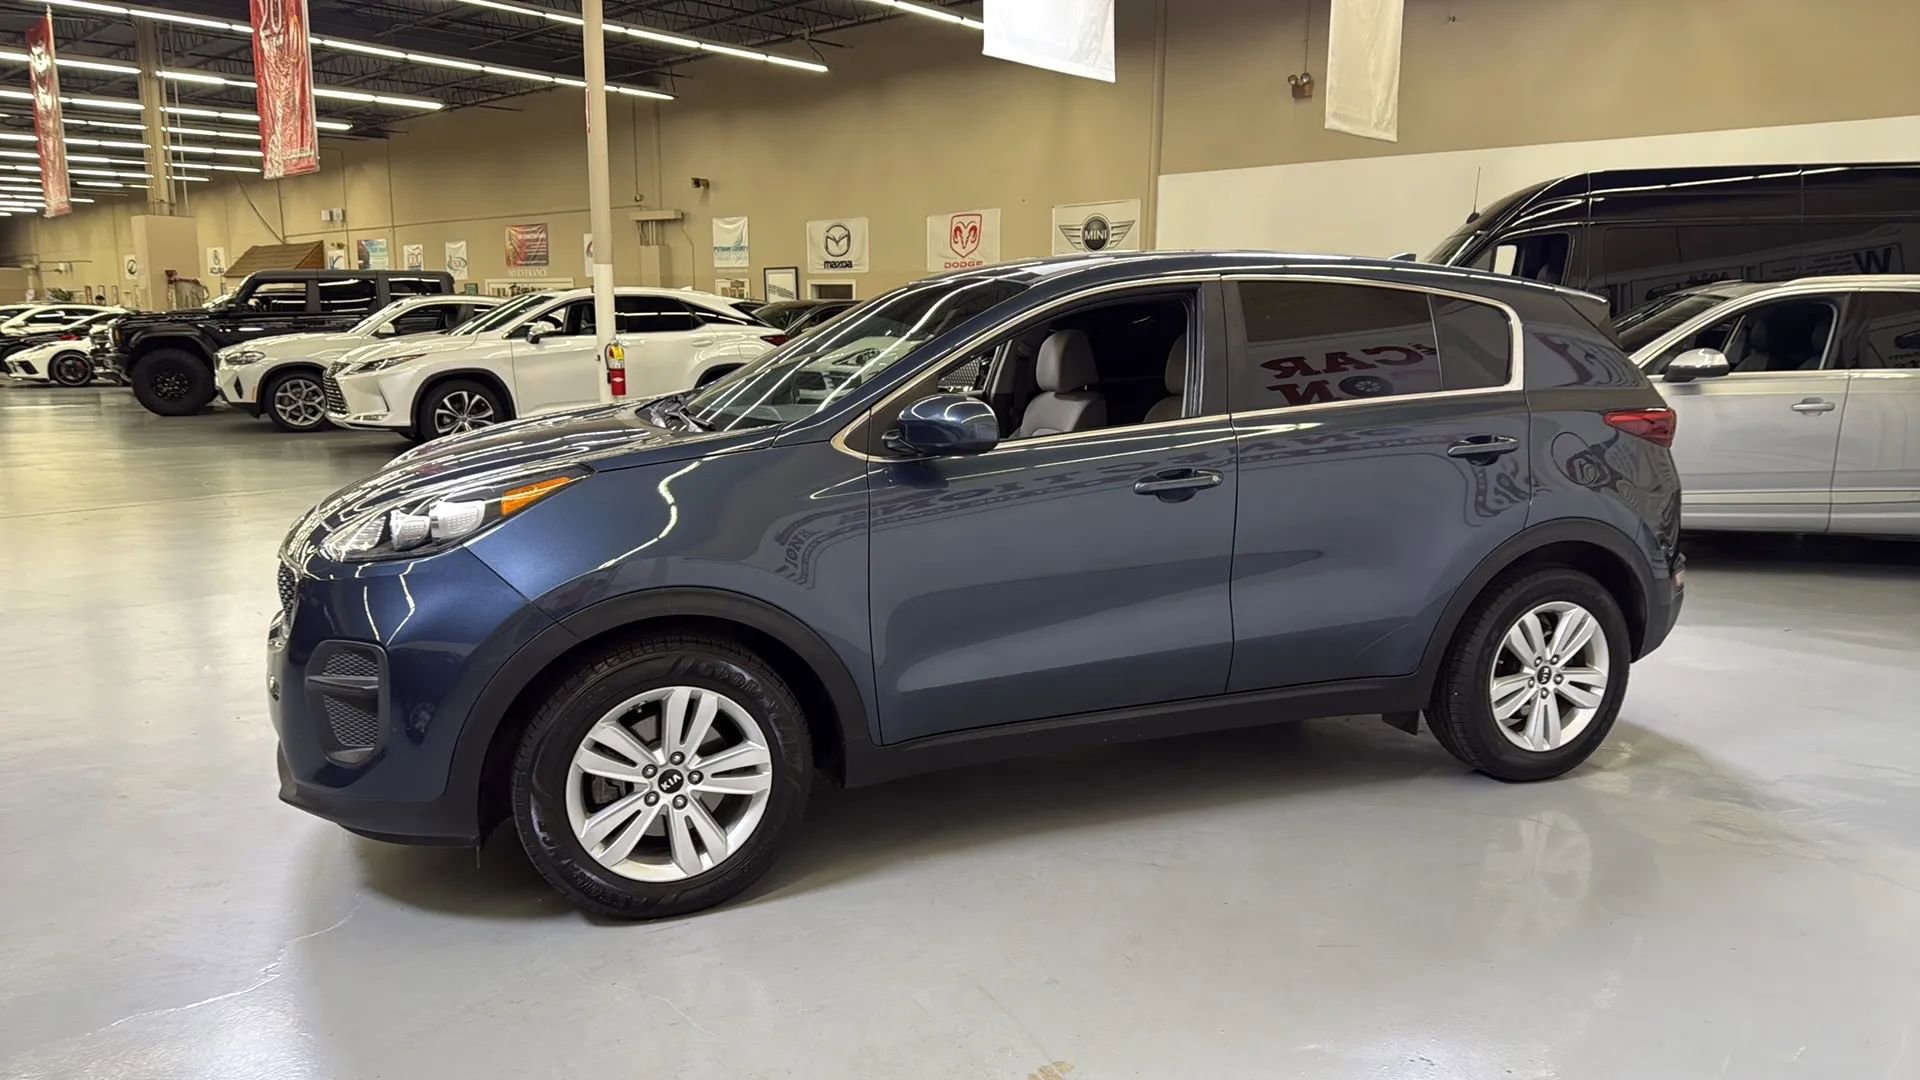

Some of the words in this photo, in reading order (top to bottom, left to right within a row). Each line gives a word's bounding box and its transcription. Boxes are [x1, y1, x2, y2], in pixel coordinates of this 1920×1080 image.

[1084, 229, 1107, 241] MINI
[824, 260, 853, 270] mazda
[944, 260, 983, 269] DODGE
[660, 773, 682, 791] KIA
